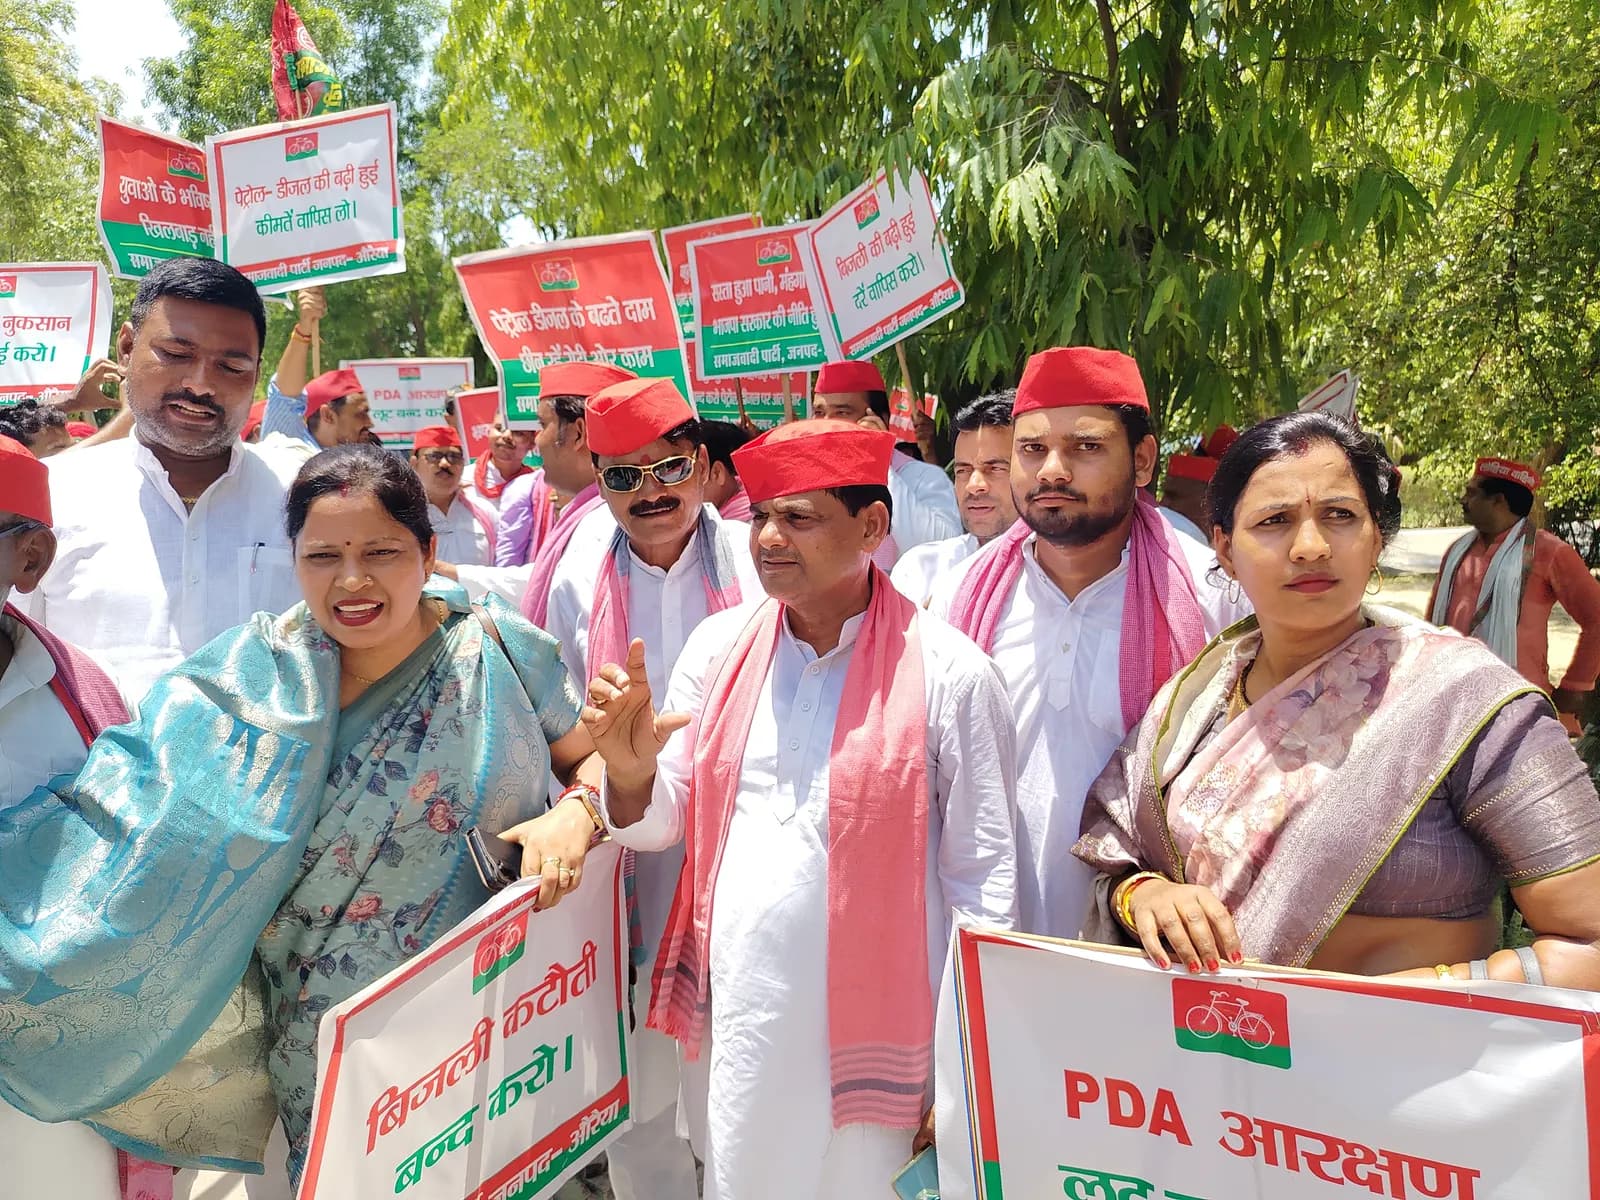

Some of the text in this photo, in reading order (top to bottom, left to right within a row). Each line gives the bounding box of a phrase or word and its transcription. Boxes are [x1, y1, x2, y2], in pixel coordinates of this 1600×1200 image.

[159, 180, 176, 205] के
[276, 177, 311, 199] डीजल
[313, 168, 330, 192] की
[334, 163, 355, 191] बढ़ी
[358, 159, 379, 190] हुई
[256, 209, 294, 236] कीमतें
[296, 205, 332, 229] वापिस
[868, 231, 886, 258] की
[900, 203, 917, 244] हुई
[734, 276, 753, 305] हुआ
[779, 267, 807, 292] मंहगा
[867, 272, 899, 301] वापिस
[3, 315, 73, 337] नुकसान
[530, 301, 571, 332] डीजल
[568, 299, 586, 328] के
[622, 297, 657, 322] दाम
[712, 315, 739, 336] भाजपा
[741, 311, 774, 333] सरकार
[772, 304, 787, 328] की
[787, 301, 810, 327] नीति
[617, 345, 656, 369] काम
[713, 348, 760, 369] समाजवादी
[373, 390, 401, 400] PDA
[366, 940, 598, 1156] बिजली कटौती
[394, 1104, 480, 1194] बन्द
[1063, 1068, 1481, 1200] PDA आरक्षण
